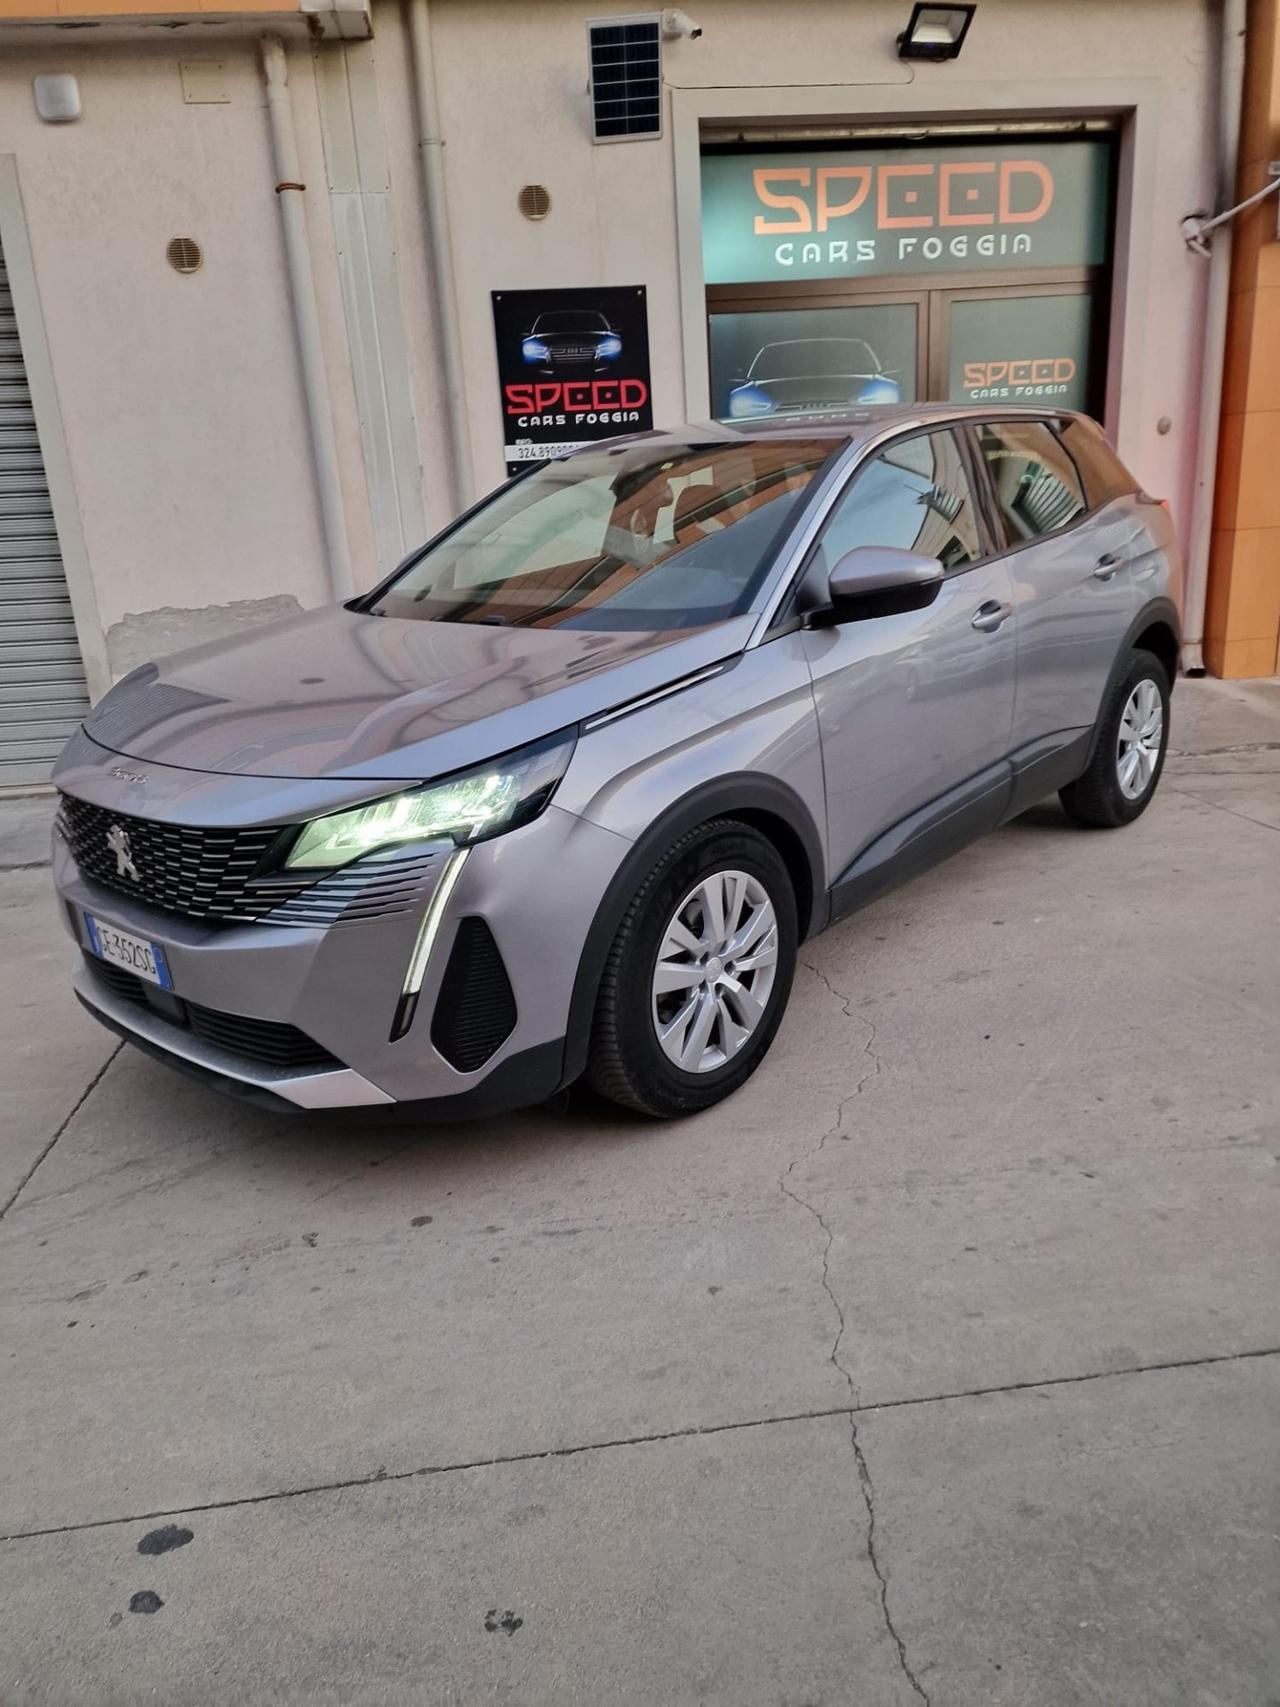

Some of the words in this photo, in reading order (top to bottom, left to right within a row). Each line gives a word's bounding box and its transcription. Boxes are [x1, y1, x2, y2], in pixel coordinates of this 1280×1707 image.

[753, 160, 1054, 235] SPEED
[775, 240, 875, 265] CARS
[899, 233, 1031, 259] FOGGIA
[963, 357, 1076, 388] SPEED
[505, 379, 647, 414] SPEED
[970, 387, 1009, 399] CARS
[1015, 384, 1067, 396] FOGGIA
[517, 415, 566, 427] CARS
[575, 411, 639, 424] FOGGIA
